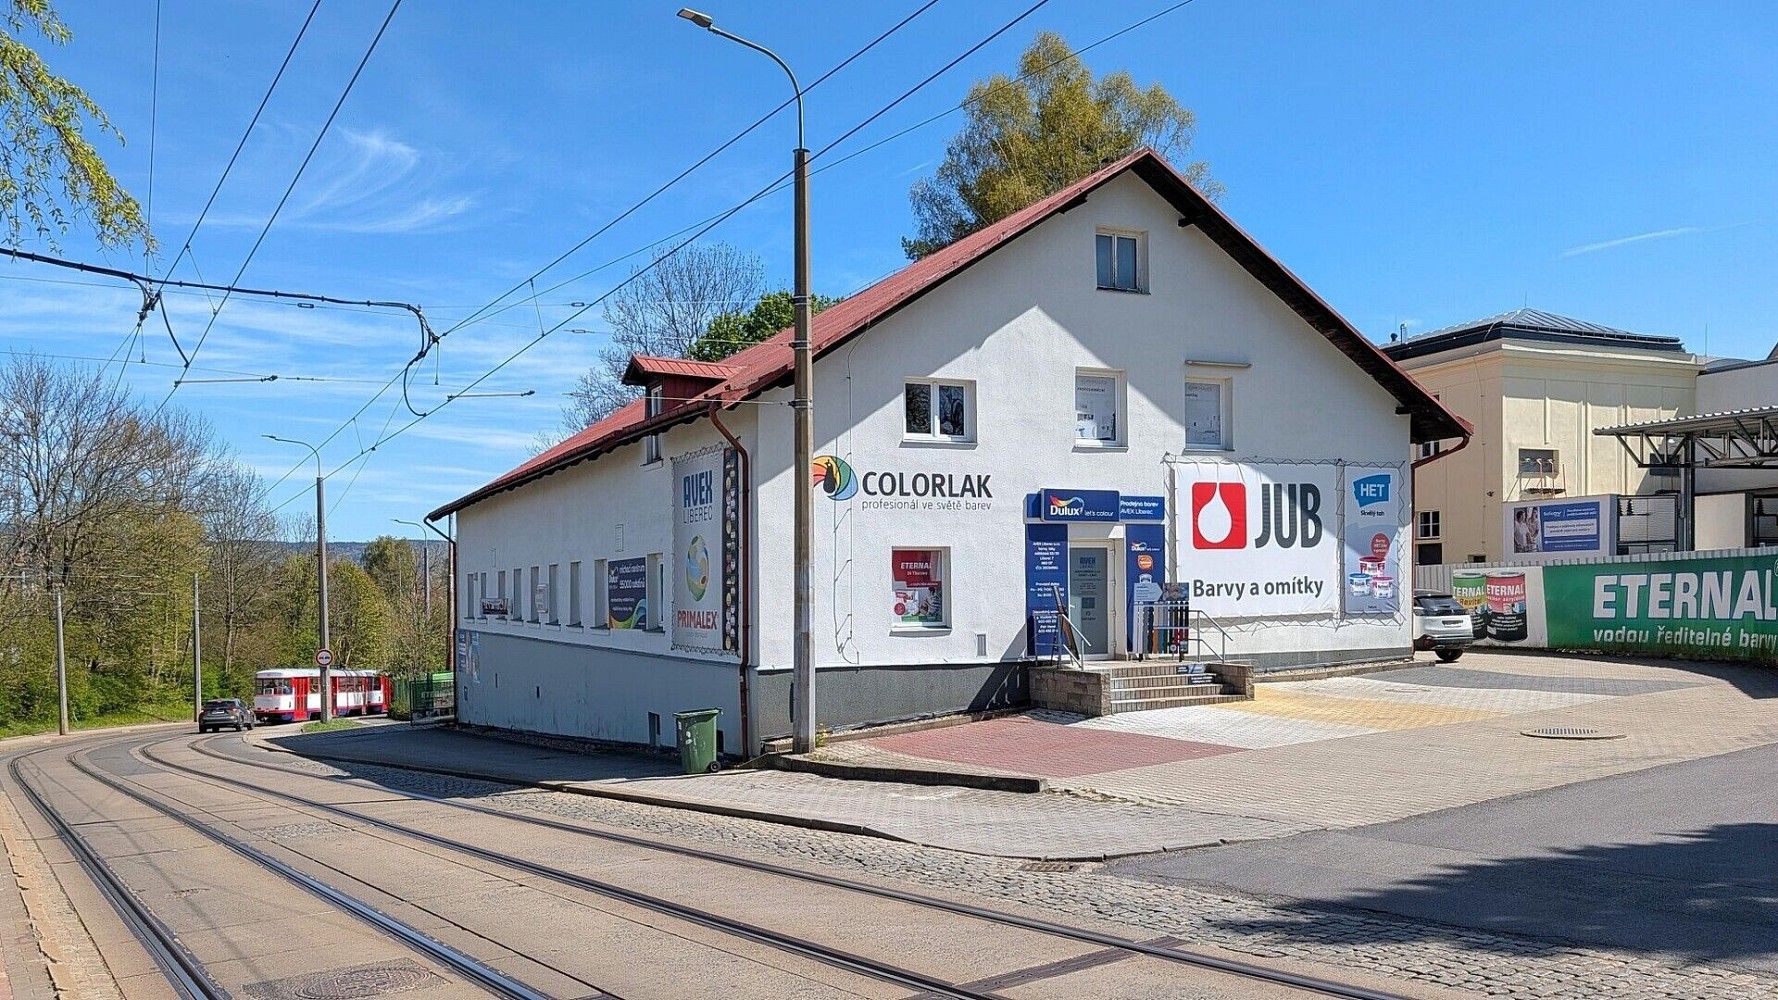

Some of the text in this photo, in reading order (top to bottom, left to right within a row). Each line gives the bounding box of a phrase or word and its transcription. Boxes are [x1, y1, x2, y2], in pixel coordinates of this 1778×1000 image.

[683, 470, 713, 508] AVEX
[862, 471, 993, 498] COLORLAK
[1360, 483, 1385, 497] HET
[683, 505, 713, 524] LIBEREC
[861, 499, 992, 511] profesionál ve světě barev
[1050, 505, 1080, 516] Dulux
[1254, 483, 1323, 549] JUB
[1193, 576, 1324, 601] Barvy a omítky
[1486, 583, 1524, 596] ETERNAL
[1593, 569, 1777, 620] ETERNAL
[677, 610, 718, 630] PRIMALEX
[1593, 625, 1778, 654] vodou ředitelné barvy
